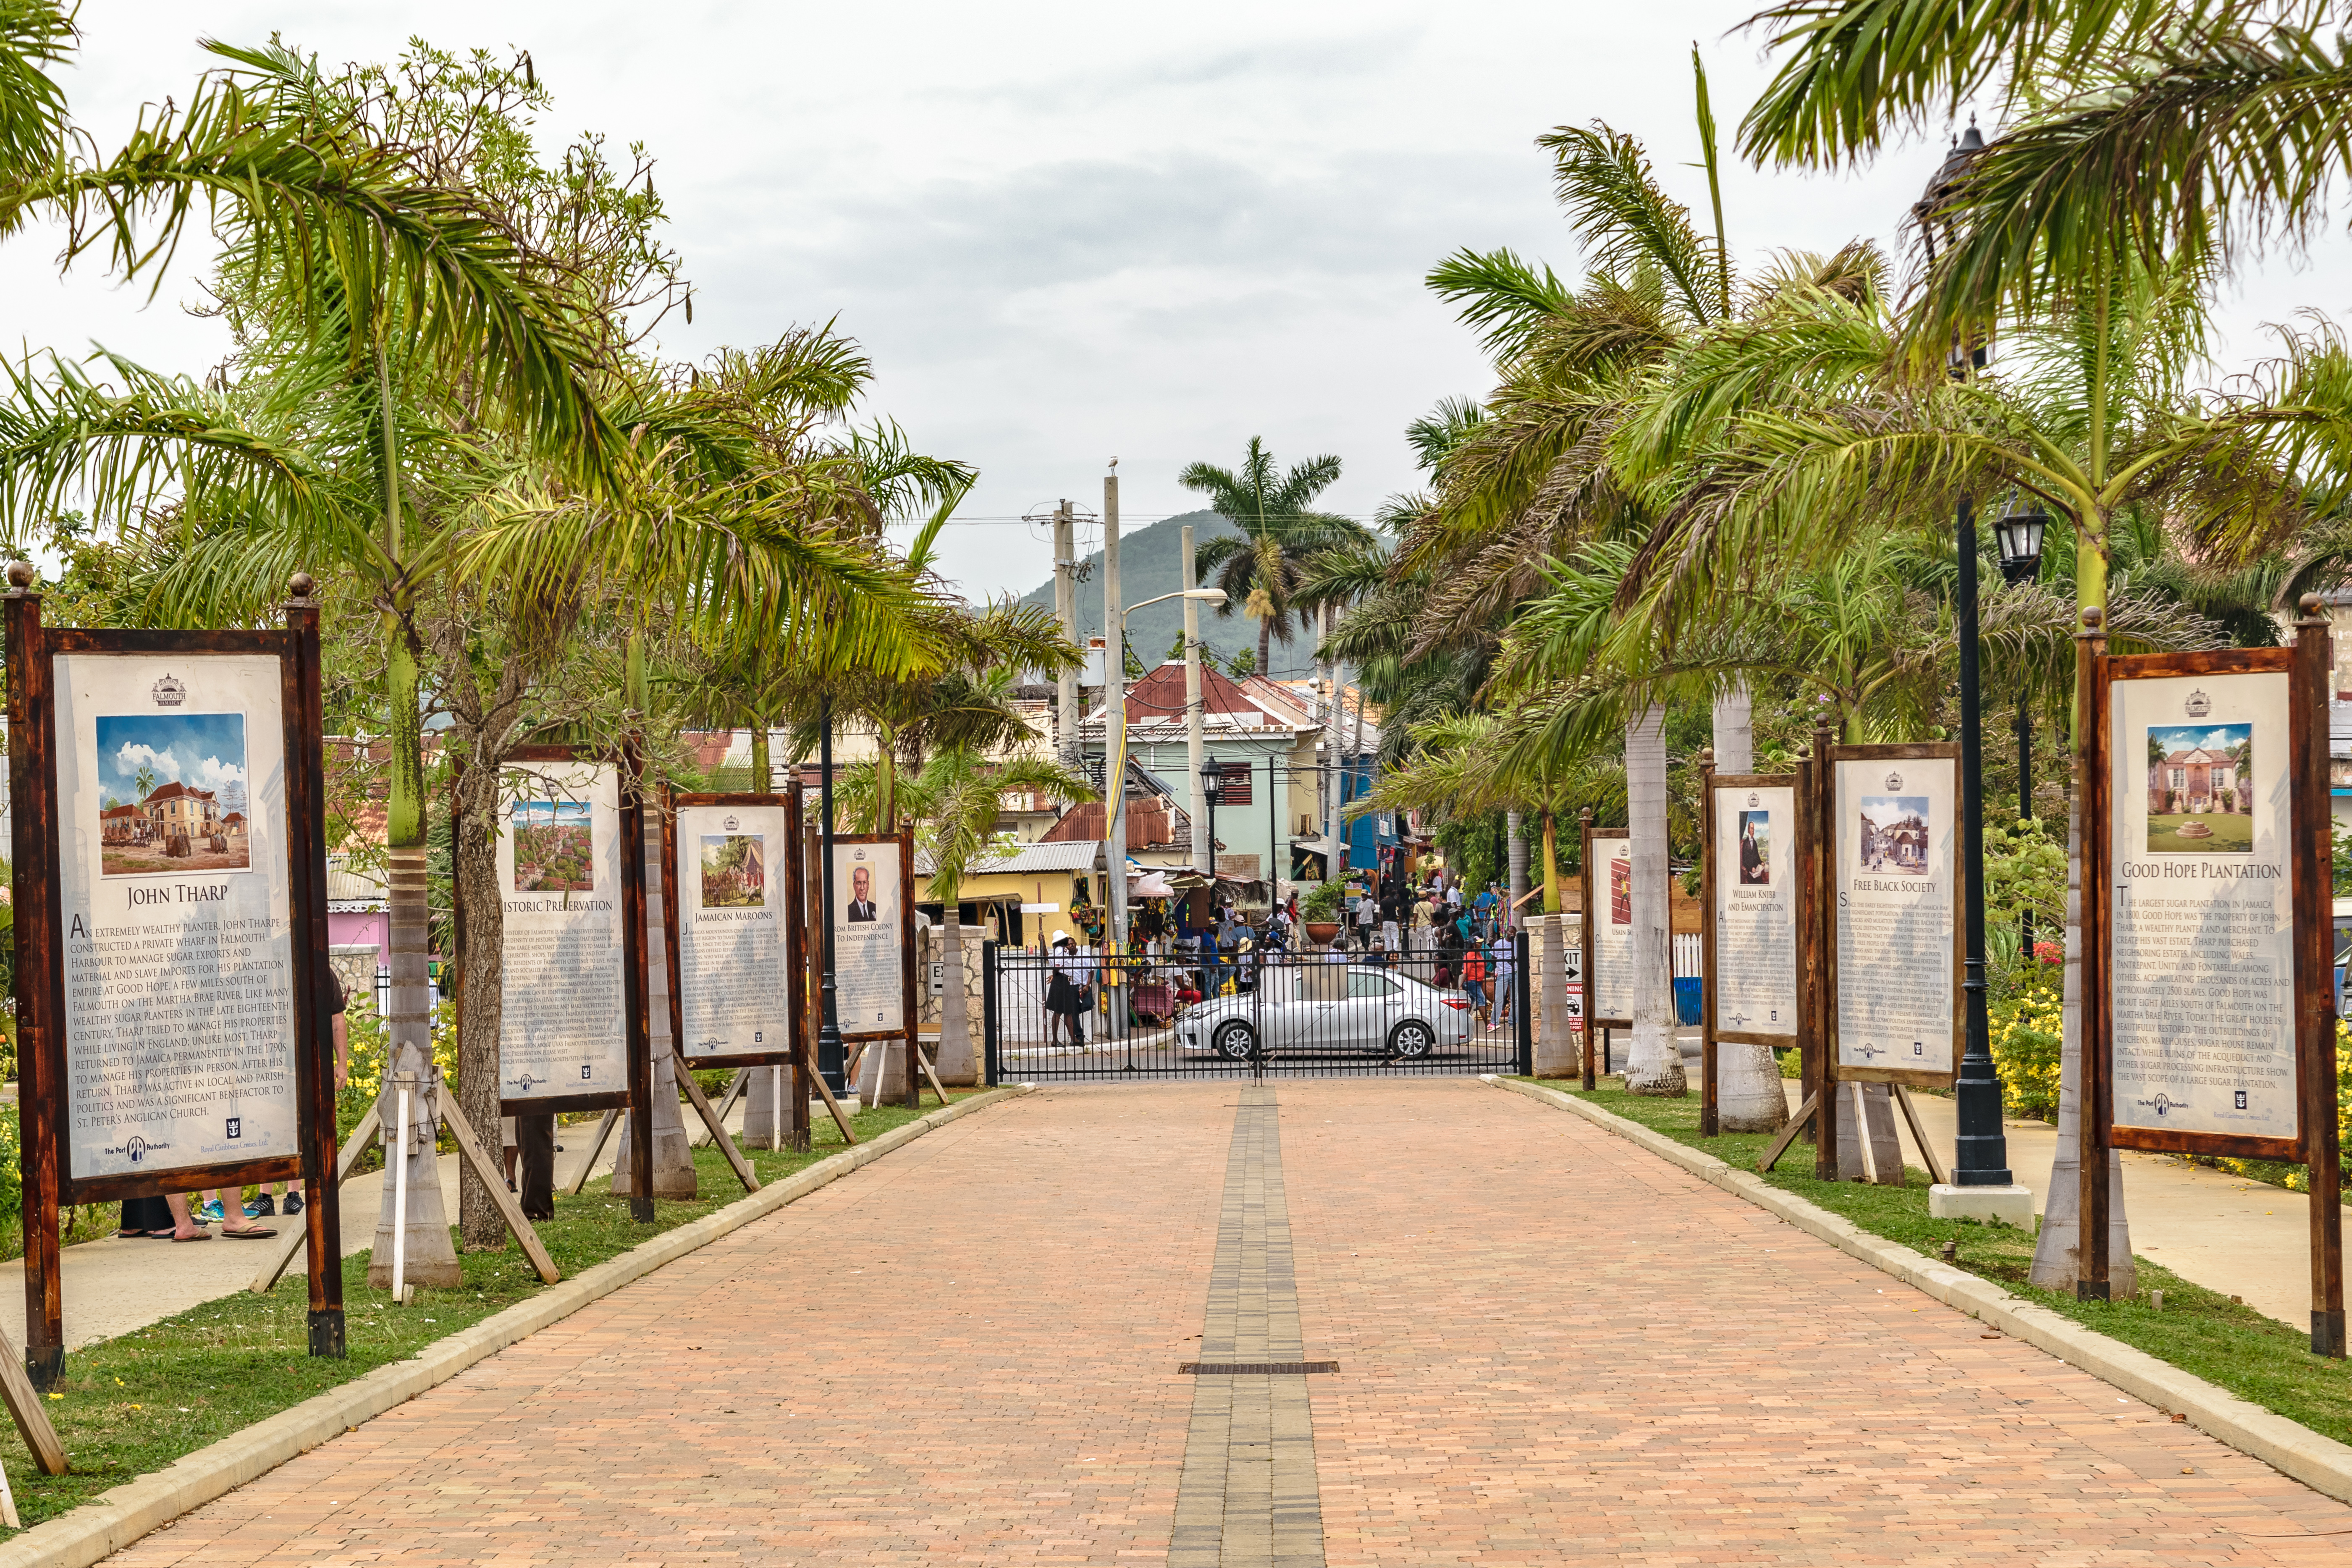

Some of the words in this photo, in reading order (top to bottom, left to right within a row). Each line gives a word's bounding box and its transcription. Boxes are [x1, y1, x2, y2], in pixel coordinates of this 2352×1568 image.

[2122, 862, 2159, 878] GOOD
[2164, 862, 2197, 878] HOPE
[2201, 862, 2281, 879] PLANTATION
[1854, 879, 1871, 891] FREE
[1874, 880, 1899, 892] BLACK
[1901, 880, 1936, 893] SOCIETY
[128, 886, 169, 910] JOHN
[176, 885, 227, 902] THARP
[1733, 889, 1757, 899] WILLIAM
[1758, 889, 1776, 899] KNIBB
[504, 901, 543, 912] ISTORIC
[1741, 902, 1783, 911] EMANCIPATION
[2138, 899, 2165, 907] LARGEST
[2166, 899, 2188, 907] SUGAR
[2189, 899, 2230, 908] PLANTATION
[2232, 899, 2240, 908] IN
[2242, 900, 2273, 911] JAMAICA
[695, 912, 732, 924] JAMAICAN
[735, 912, 772, 920] MAROONS
[95, 926, 140, 937] EXTREMELY
[142, 923, 180, 934] WEALTHY
[183, 921, 220, 932] PLANTER,
[223, 920, 246, 930] JOHN
[249, 918, 280, 928] THARPE
[70, 941, 132, 953] CONSTRUCTED
[134, 941, 139, 949] A
[142, 939, 173, 949] PRIVATE
[176, 936, 205, 946] WHARF
[208, 935, 218, 945] IN
[220, 933, 265, 944] FALMOUTH
[847, 933, 888, 941] INDEPENDENCE
[71, 957, 113, 968] HARBOUR
[116, 955, 126, 965] TO
[129, 953, 164, 964] MANAGE
[166, 952, 193, 962] SUGAR
[196, 949, 230, 960] EXPORTS
[233, 947, 251, 957] AND
[1564, 953, 1580, 964] XIT
[2116, 948, 2161, 957] NEIGHBORING
[2162, 949, 2189, 958] ESTATES,
[2190, 950, 2230, 959] INCLUDING
[2231, 950, 2255, 960] WALES,
[71, 971, 111, 982] MATERIAL
[114, 970, 132, 980] AND
[135, 968, 157, 978] SLAVE
[160, 965, 196, 976] IMPORTS
[198, 964, 215, 974] FOR
[217, 962, 231, 973] HIS
[233, 960, 284, 971] PLANTATION
[72, 986, 102, 997] EMPIRE
[105, 986, 113, 996] AT
[116, 983, 143, 994] GOOD
[146, 981, 170, 992] HOPE,
[173, 981, 178, 990] A
[181, 979, 197, 989] FEW
[200, 977, 225, 988] MILES
[225, 975, 254, 986] SOUTH
[257, 974, 267, 984] OF
[2116, 973, 2142, 982] OTHERS,
[2143, 974, 2195, 983] ACCUMULATING
[2196, 975, 2237, 984] THOUSANDS
[2239, 976, 2249, 985] OF
[2250, 977, 2272, 986] ACRES
[2273, 978, 2290, 987] AND
[73, 999, 118, 1012] FALMOUTH
[121, 998, 134, 1008] ON
[138, 997, 153, 1007] THE
[156, 994, 191, 1005] MARTHA
[194, 992, 214, 1002] BRAE
[217, 990, 242, 1001] RIVER.
[245, 989, 262, 999] LIKE
[265, 987, 288, 997] MANY
[2117, 1022, 2156, 1032] BEAUTIFULLY
[2157, 1022, 2192, 1033] RESTORED.
[2193, 1025, 2207, 1034] THE
[2208, 1026, 2260, 1037] OUTBUILDINGS
[2262, 1026, 2271, 1037] OF
[2116, 1059, 2139, 1068] OTHER
[2140, 1061, 2161, 1070] SUGAR
[2163, 1060, 2204, 1072] PROCESSING
[2205, 1064, 2265, 1075] INFRASTRUCTURE
[2266, 1067, 2288, 1076] SHOW
[76, 1101, 114, 1113] POLITICS
[117, 1099, 135, 1109] AND
[137, 1094, 154, 1107] WAS
[164, 1091, 216, 1105] SIGNIFICANT
[219, 1086, 270, 1099] BENEFACTOR
[273, 1085, 283, 1094] TO
[77, 1117, 88, 1128] ST.
[91, 1114, 121, 1126] PETER'S
[124, 1111, 167, 1123] ANGLICAN
[170, 1107, 209, 1118] CHURCH.
[201, 1145, 214, 1154] Royal
[215, 1143, 239, 1151] Caribbean
